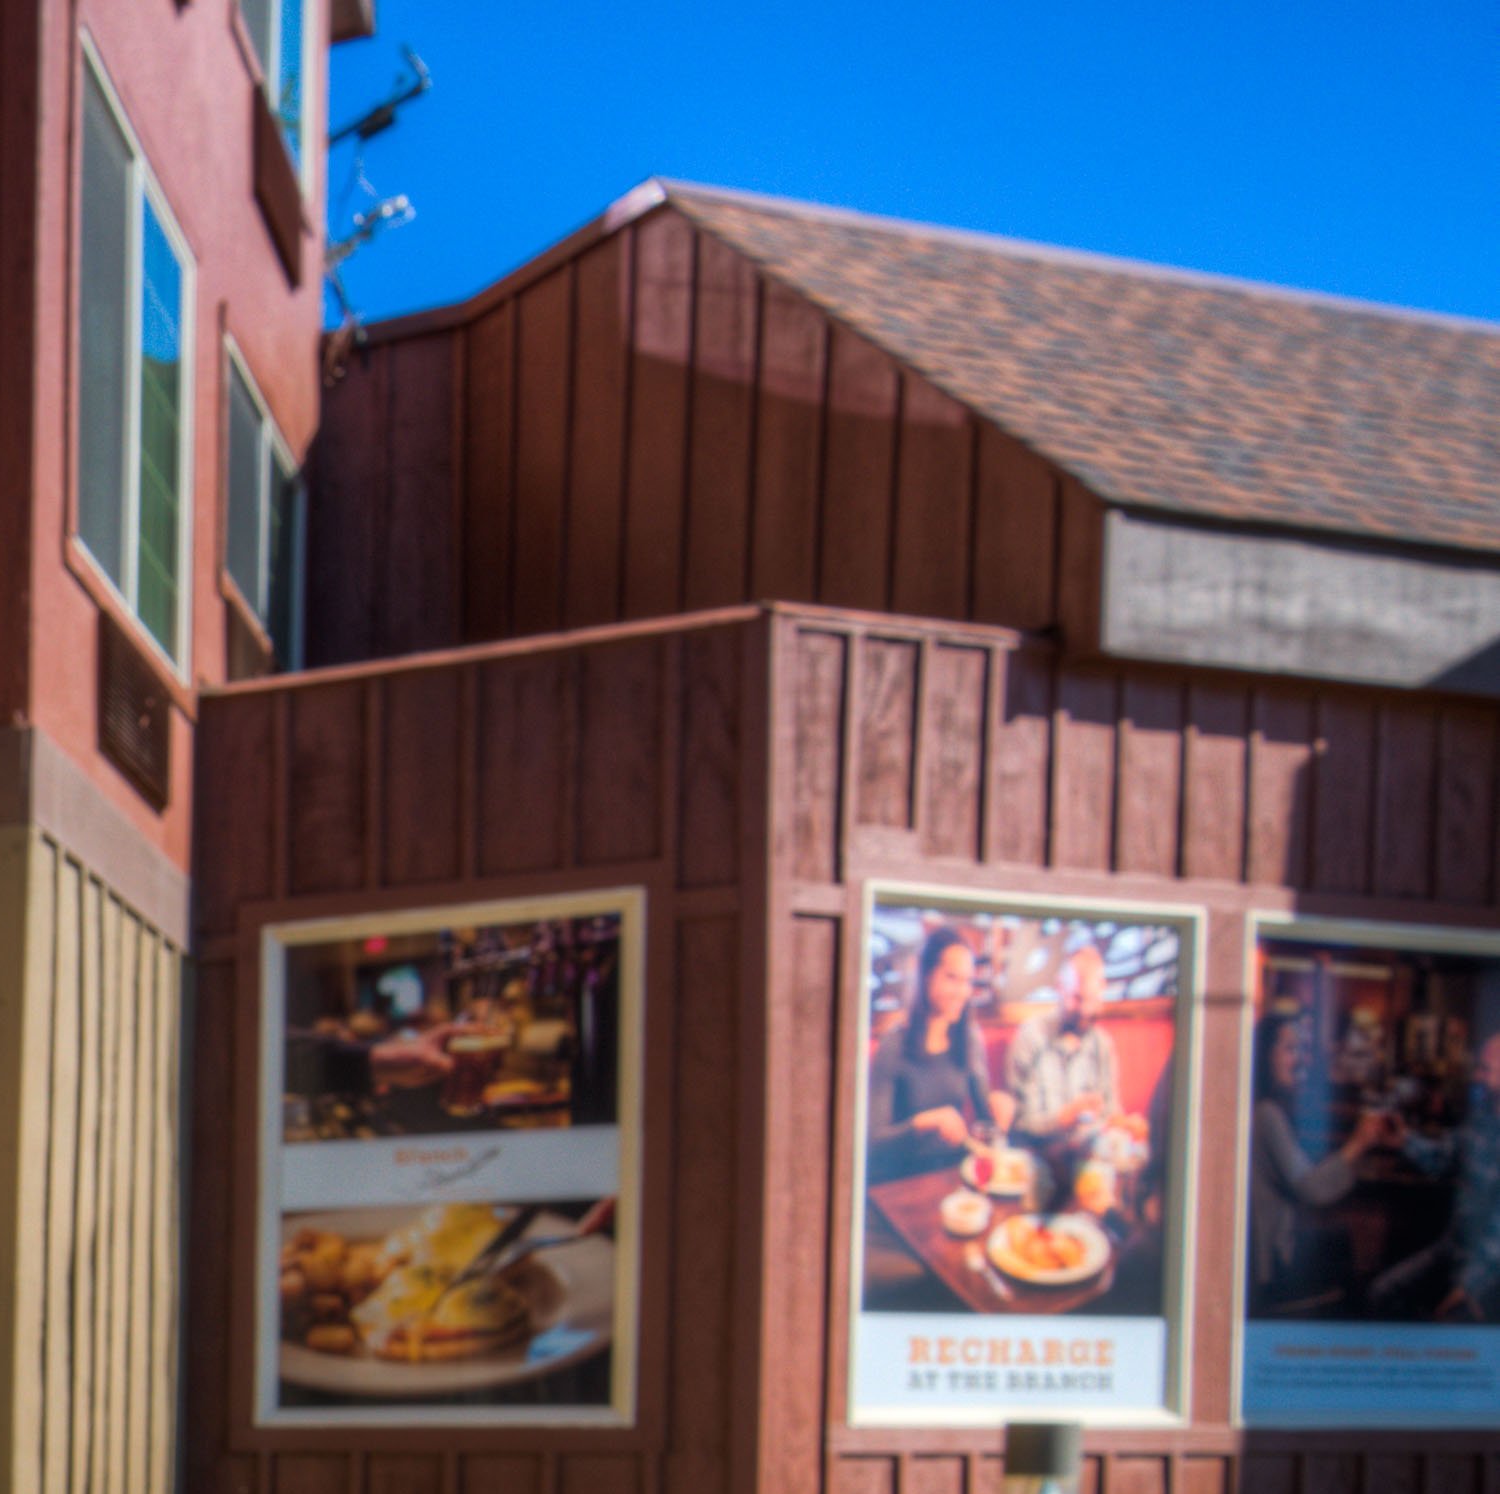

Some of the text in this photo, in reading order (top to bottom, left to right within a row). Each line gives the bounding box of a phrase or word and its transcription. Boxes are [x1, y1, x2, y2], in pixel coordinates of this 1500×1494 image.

[908, 1335, 1114, 1366] RECHARGE
[908, 1370, 938, 1390] AT
[947, 1370, 998, 1390] THE
